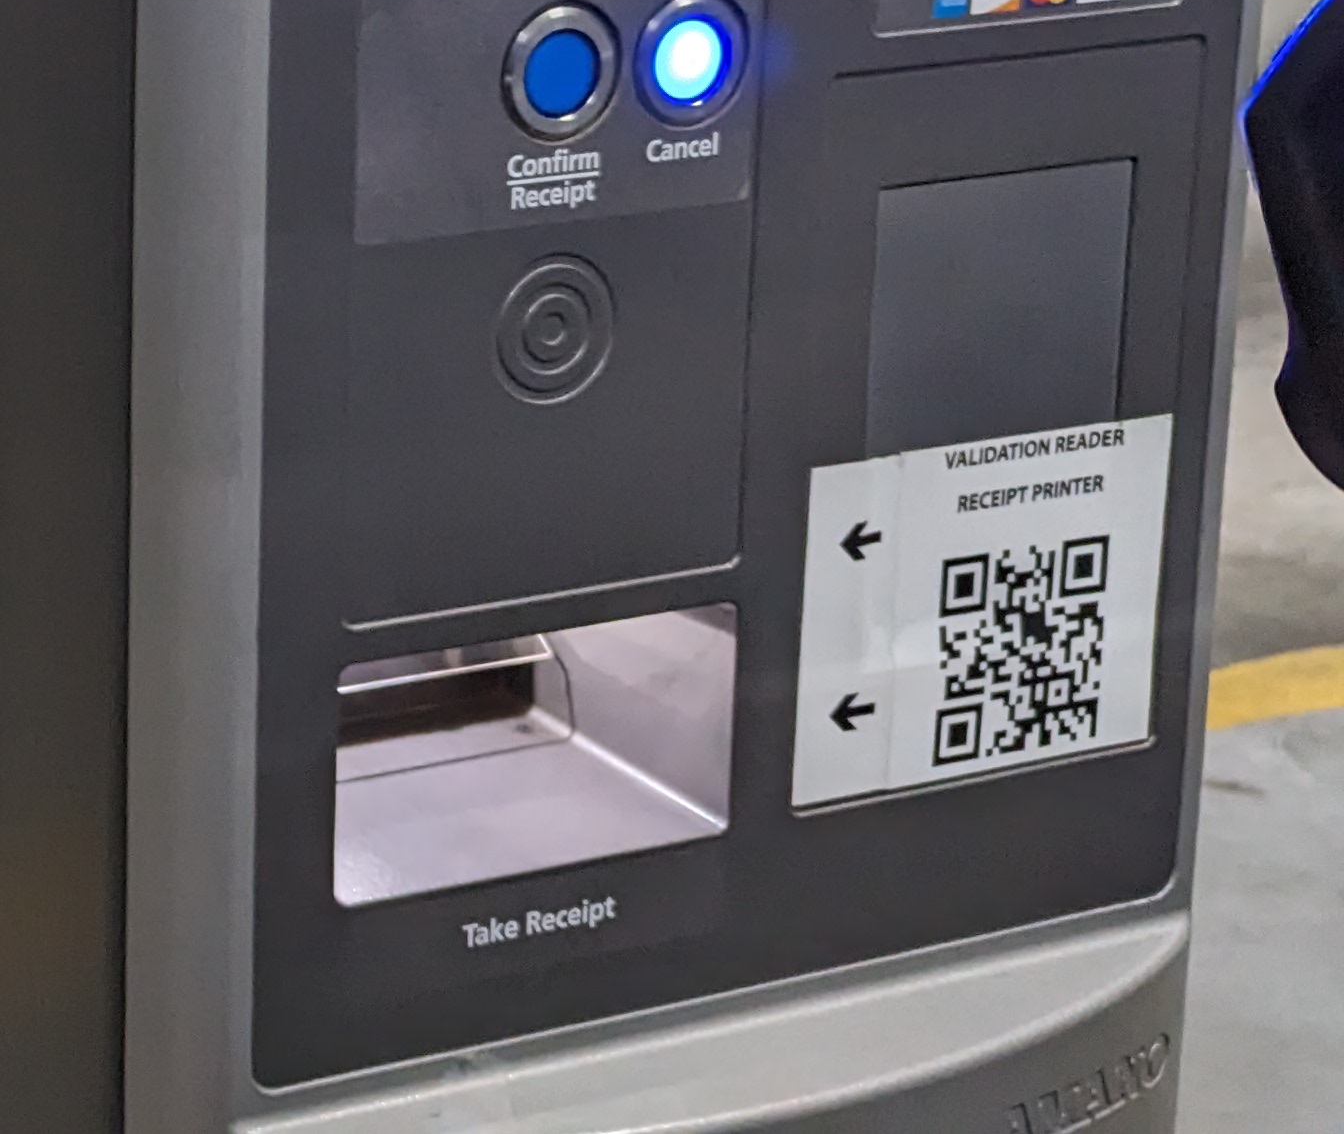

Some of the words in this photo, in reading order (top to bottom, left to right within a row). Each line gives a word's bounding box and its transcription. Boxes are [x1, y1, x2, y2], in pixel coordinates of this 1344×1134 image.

[507, 148, 600, 178] Confirm
[646, 132, 720, 163] Cancel
[511, 180, 596, 210] Receipt
[945, 439, 1051, 469] VALIDATION
[1055, 428, 1125, 453] READER
[957, 486, 1029, 514] RECEIPT
[1032, 474, 1104, 501] PRINTER
[462, 917, 520, 948] Take
[525, 896, 617, 936] Receipt
